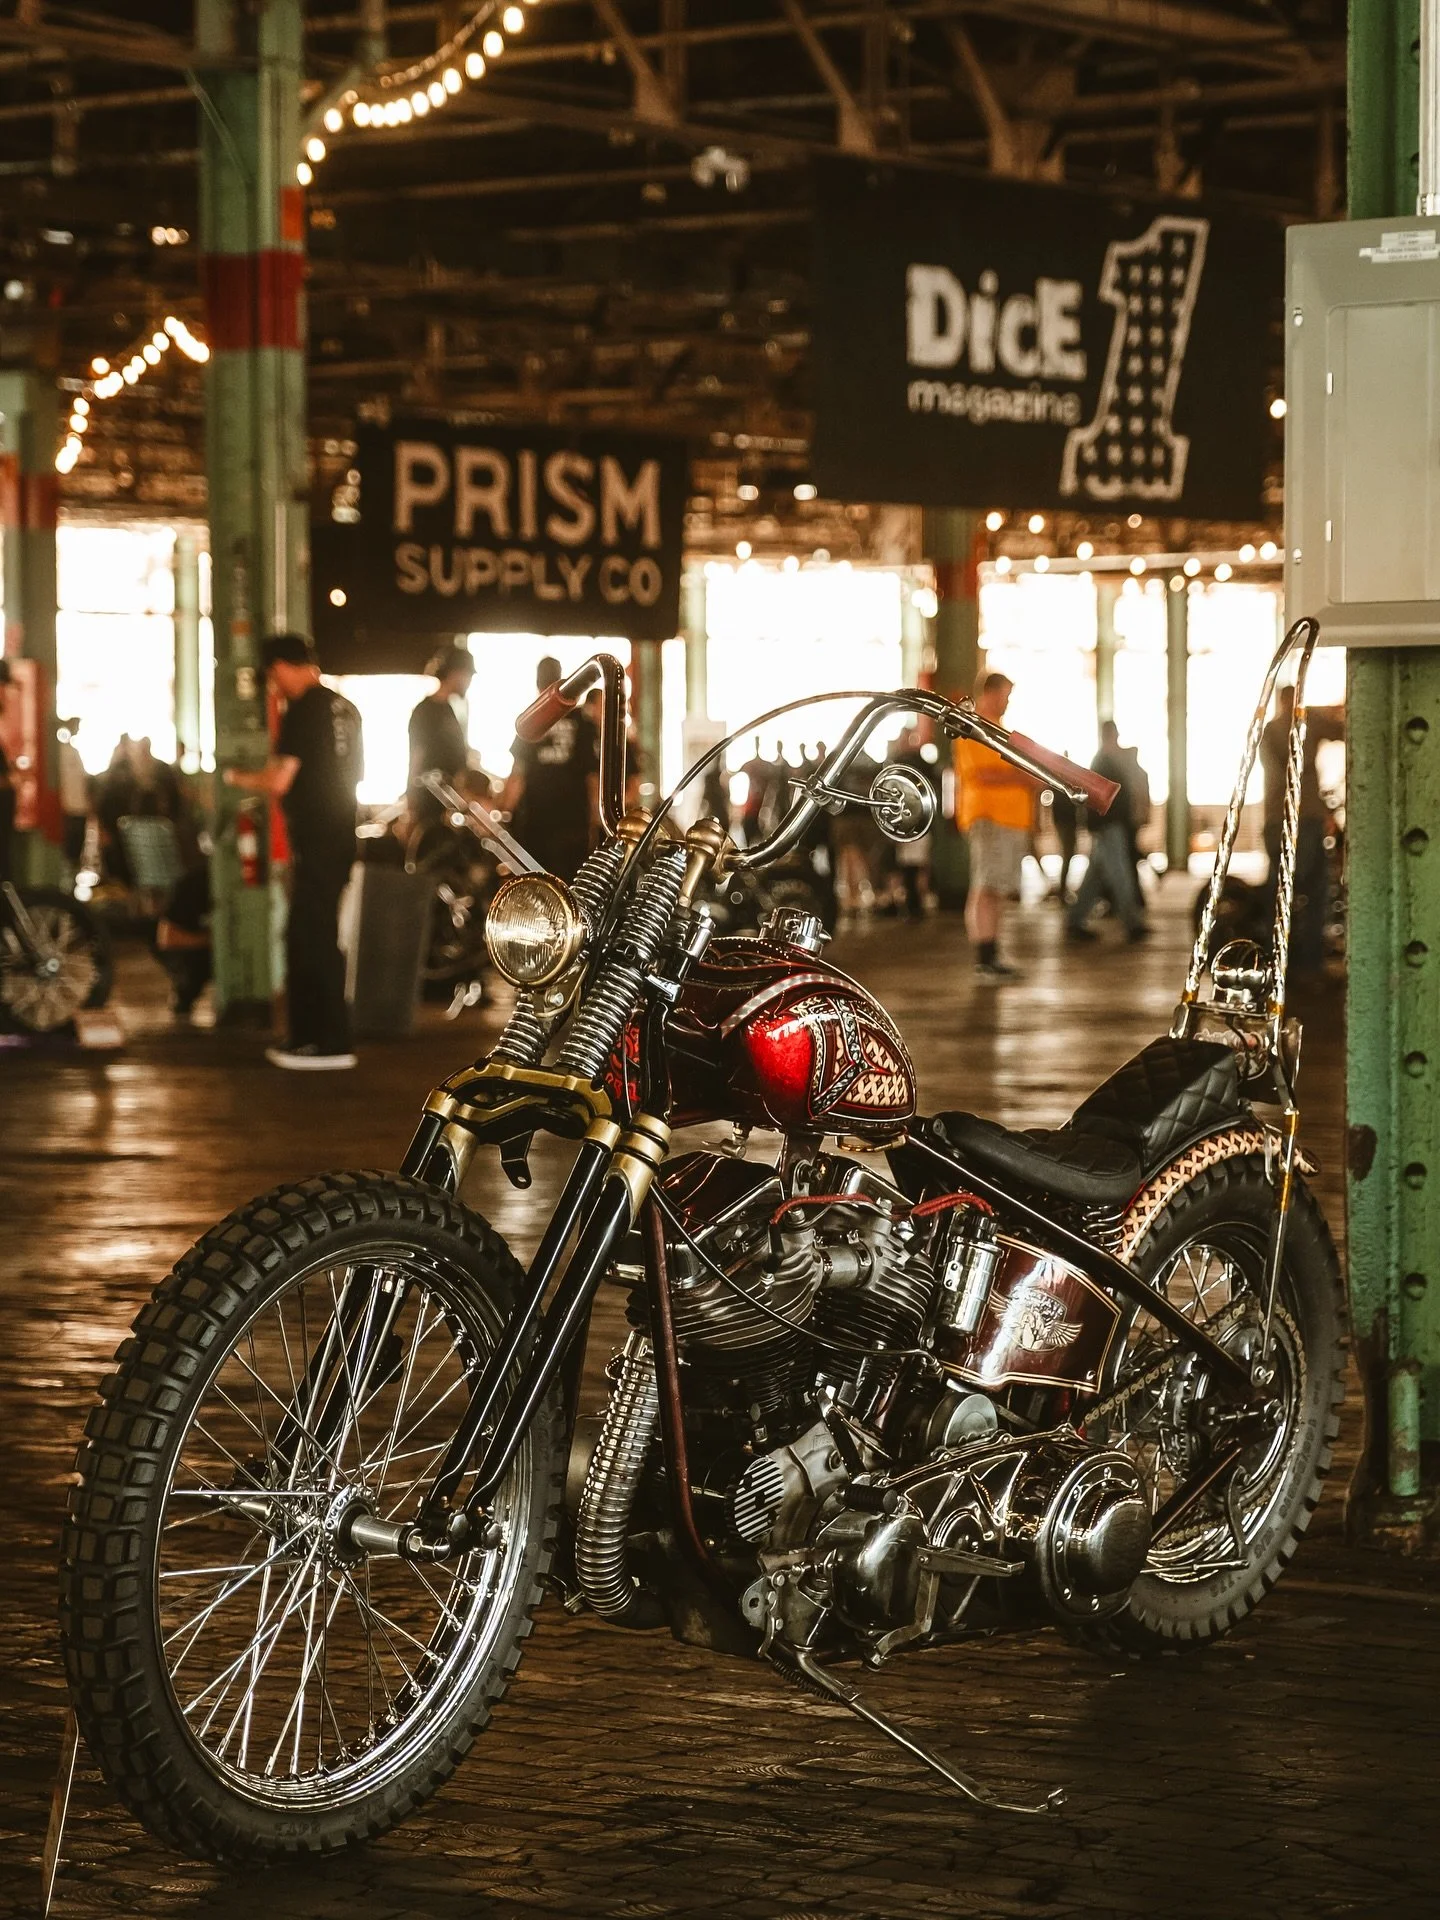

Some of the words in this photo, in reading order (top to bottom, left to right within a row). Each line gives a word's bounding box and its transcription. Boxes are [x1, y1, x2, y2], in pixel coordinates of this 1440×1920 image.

[905, 262, 1087, 382] DicE
[906, 379, 1082, 426] magazine
[393, 439, 661, 549] PRISM
[394, 543, 593, 601] SUPPLY
[600, 554, 662, 607] CO
